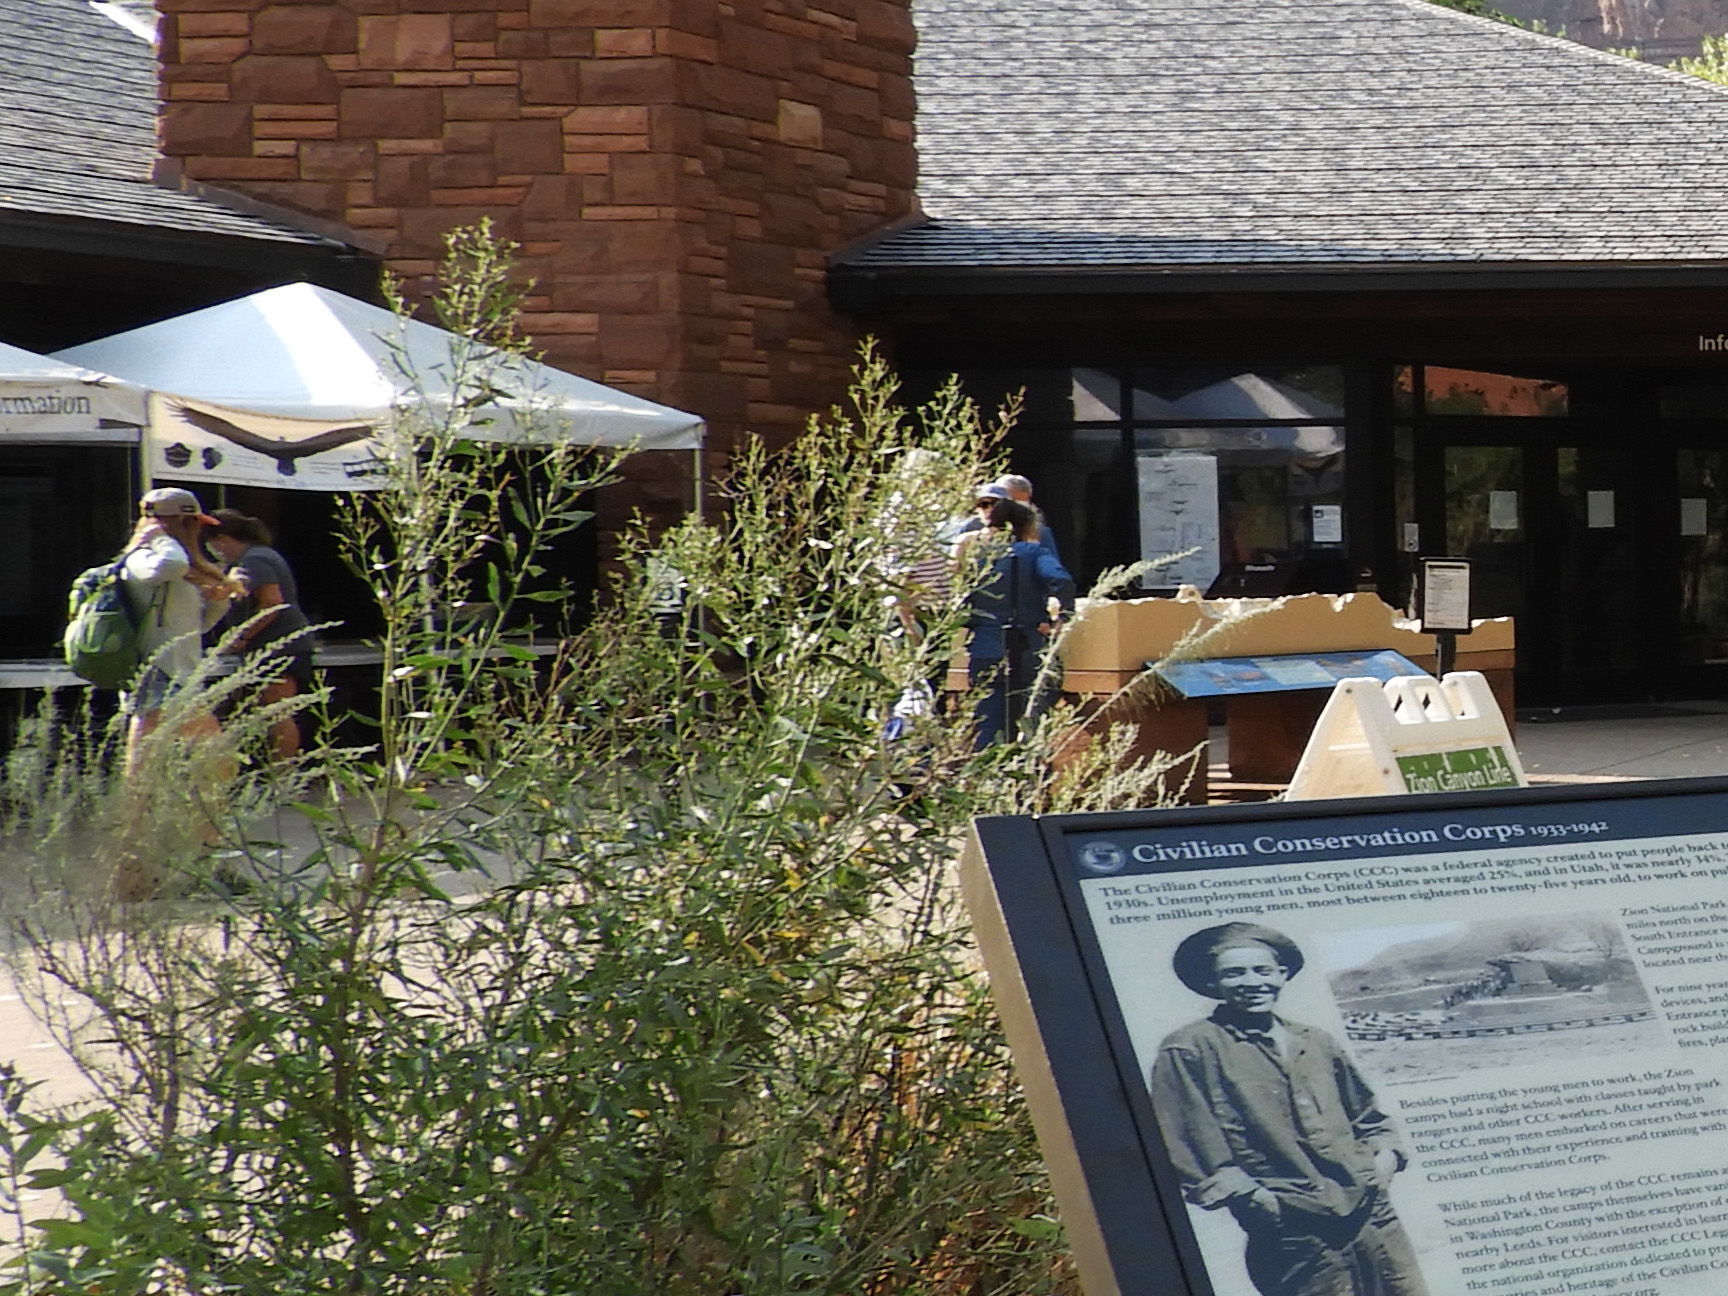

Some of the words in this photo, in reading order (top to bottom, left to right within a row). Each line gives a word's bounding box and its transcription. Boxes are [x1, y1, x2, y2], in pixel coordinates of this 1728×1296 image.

[0, 389, 91, 414] rmation
[1406, 774, 1438, 792] Zion
[1438, 769, 1484, 791] Canyon
[1484, 764, 1512, 783] Line
[1132, 838, 1248, 864] Civilian
[1254, 826, 1438, 856] Conservation
[1443, 821, 1526, 845] Corps
[1530, 820, 1609, 837] 1933-1942
[1098, 885, 1131, 897] The
[1133, 881, 1197, 894] Civilian
[1198, 874, 1302, 889] Conservation
[1303, 870, 1350, 881] Corps
[1351, 864, 1400, 880] (CCC)
[1401, 865, 1428, 873] was
[1441, 857, 1493, 870] federal
[1494, 857, 1542, 869] agency
[1545, 850, 1597, 863] created
[1597, 850, 1613, 859] to
[1614, 848, 1638, 860] put
[1640, 844, 1685, 858] people
[1685, 841, 1719, 852] back
[1103, 897, 1152, 910] 1930s.
[1155, 888, 1275, 906] Unemployment
[1277, 887, 1294, 896] in
[1295, 884, 1321, 895] the
[1322, 879, 1374, 893] United
[1374, 878, 1419, 889] States
[1421, 871, 1486, 885] averaged
[1487, 869, 1522, 880] 25%,
[1524, 866, 1551, 877] and
[1552, 866, 1569, 875] in
[1569, 862, 1608, 874] Utah,
[1609, 862, 1621, 871] it
[1622, 862, 1649, 870] was
[1650, 856, 1693, 868] nearly
[1107, 913, 1151, 924] three
[1155, 908, 1213, 920] million
[1215, 905, 1265, 918] young
[1265, 902, 1303, 912] men,
[1306, 896, 1343, 908] most
[1344, 894, 1407, 905] between
[1409, 888, 1471, 902] eighteen
[1471, 886, 1488, 895] to
[1489, 880, 1568, 894] twenty-five
[1570, 878, 1607, 890] years
[1608, 873, 1636, 884] old,
[1636, 873, 1652, 882] to
[1653, 869, 1688, 881] work
[1690, 870, 1708, 878] on
